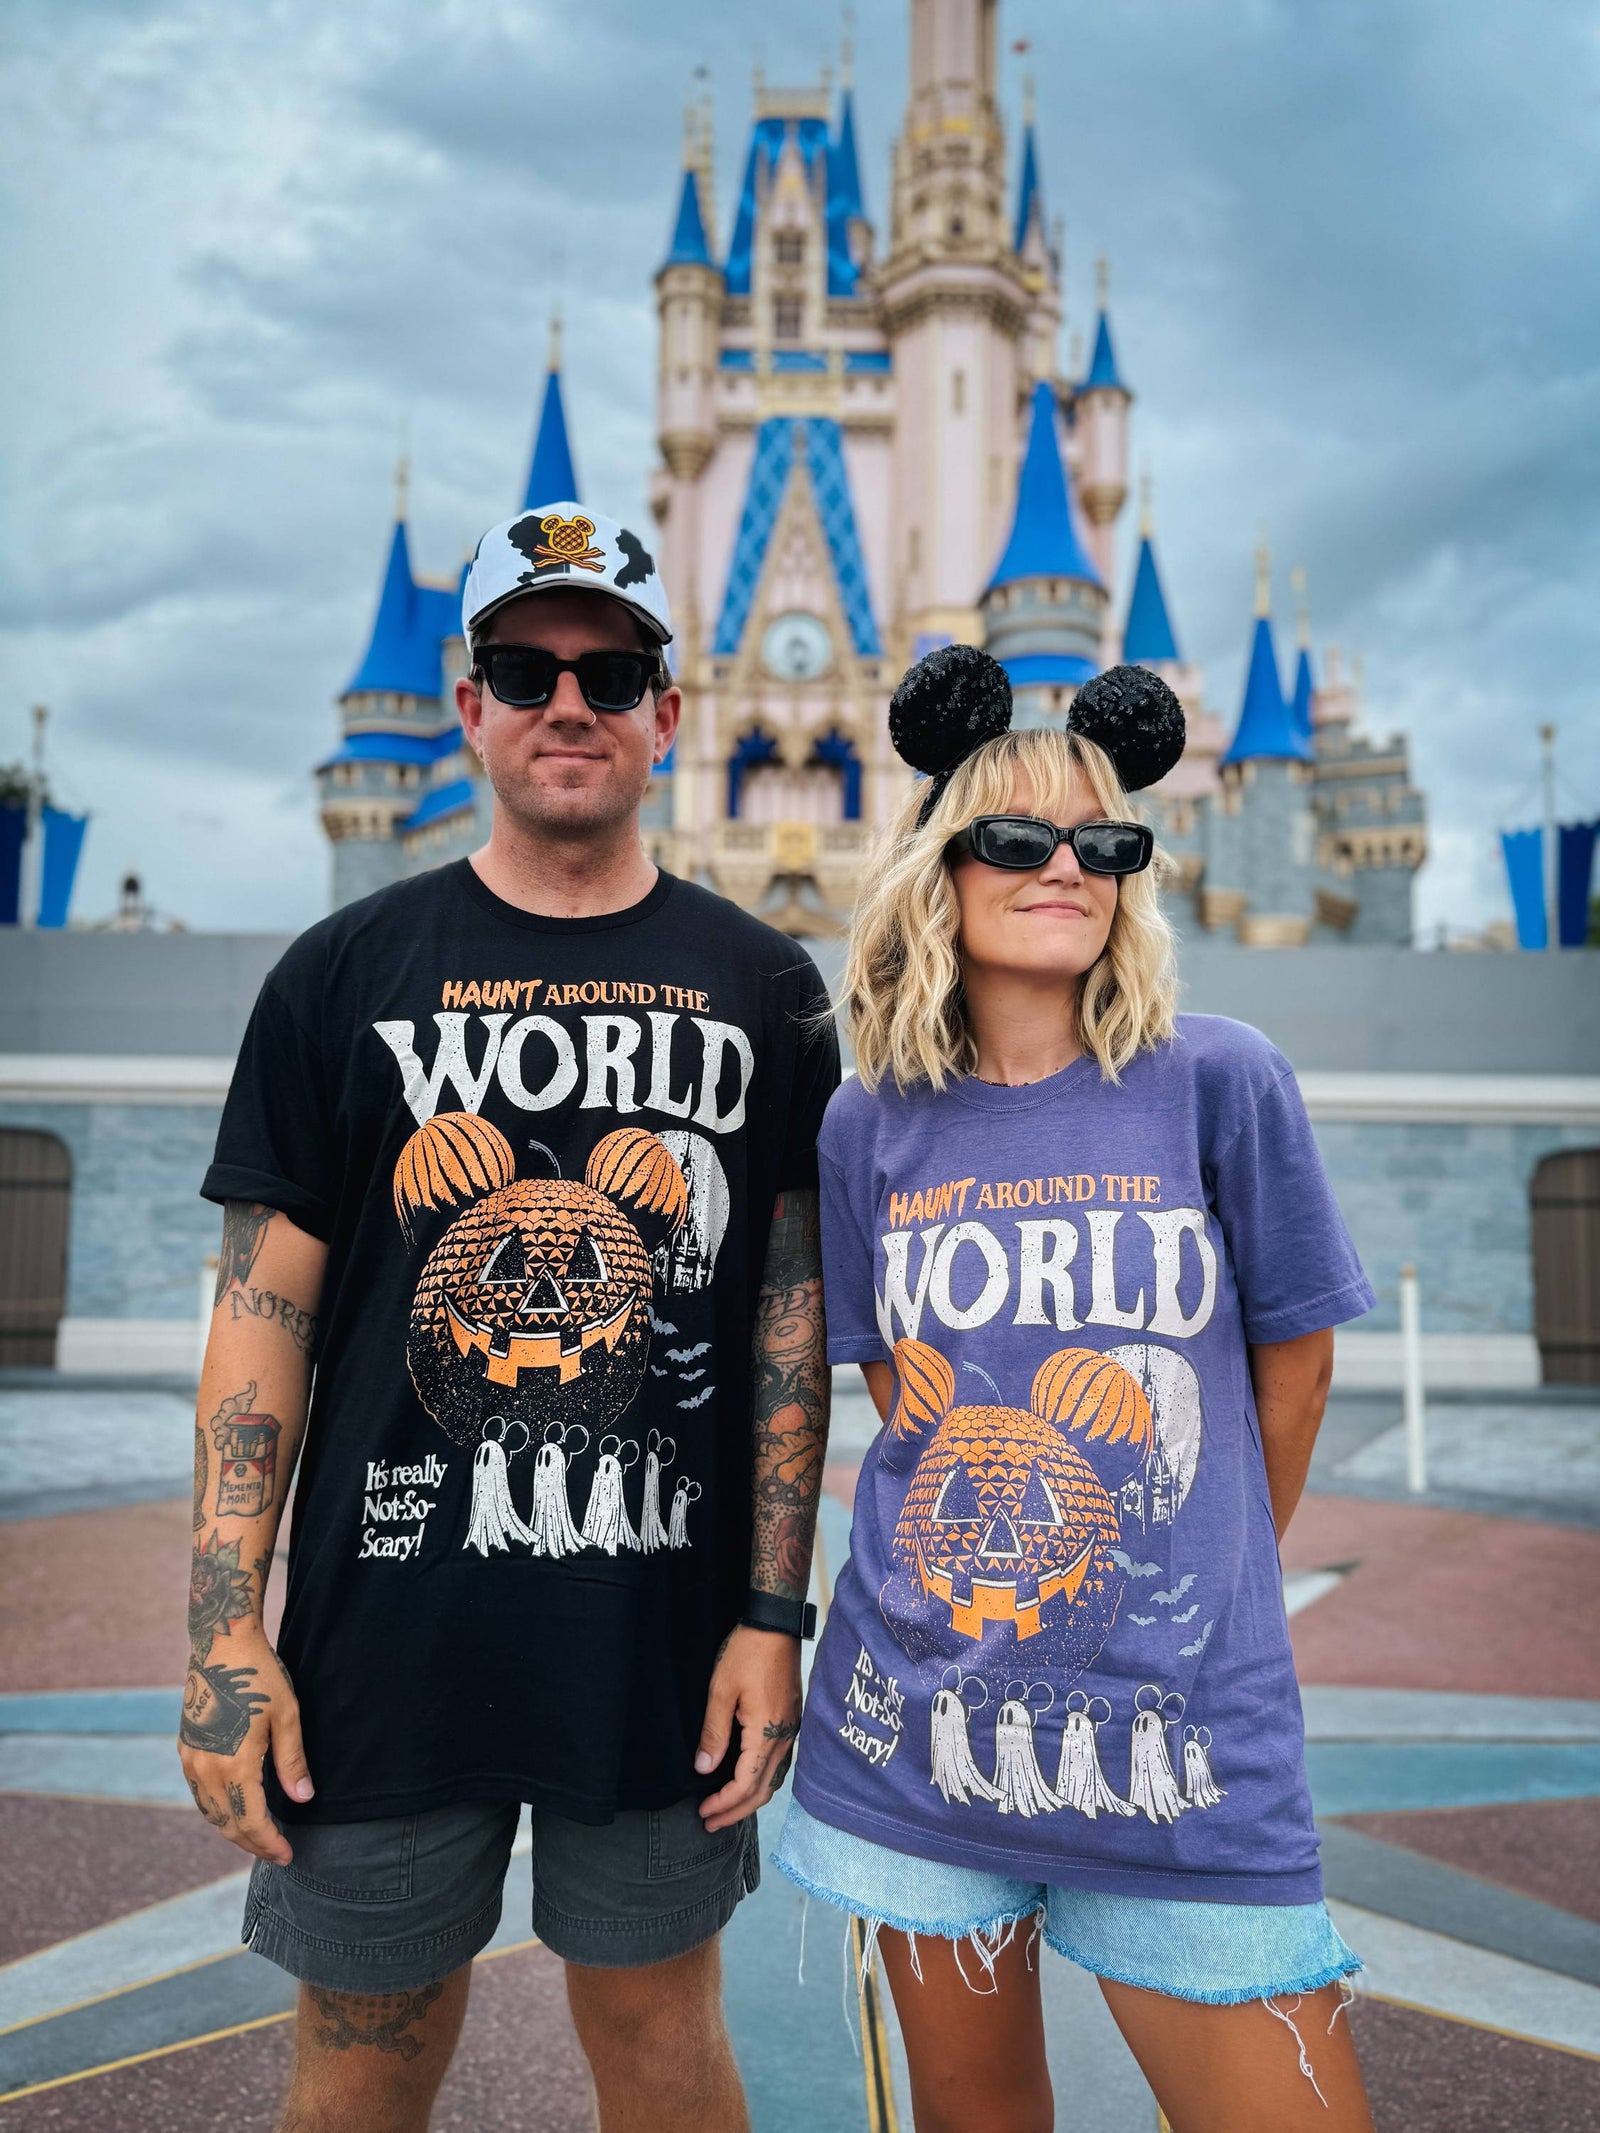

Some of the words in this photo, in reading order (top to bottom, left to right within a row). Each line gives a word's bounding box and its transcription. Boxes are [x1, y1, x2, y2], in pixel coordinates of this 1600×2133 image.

[442, 979, 543, 1011] HAUNT
[543, 981, 657, 1006] AROUND
[660, 984, 710, 1013] THE
[372, 1011, 755, 1134] WORLD
[889, 1177, 976, 1228] HAUNT
[975, 1174, 1096, 1210] AROUND
[1101, 1175, 1161, 1204] THE
[874, 1208, 1217, 1352] WORLD
[221, 1481, 261, 1493] MEMENTO
[365, 1459, 390, 1491] It's
[391, 1454, 448, 1488] really
[361, 1490, 437, 1525] Not-So-
[358, 1522, 426, 1562] Scary!
[838, 1710, 899, 1768] Scary!
